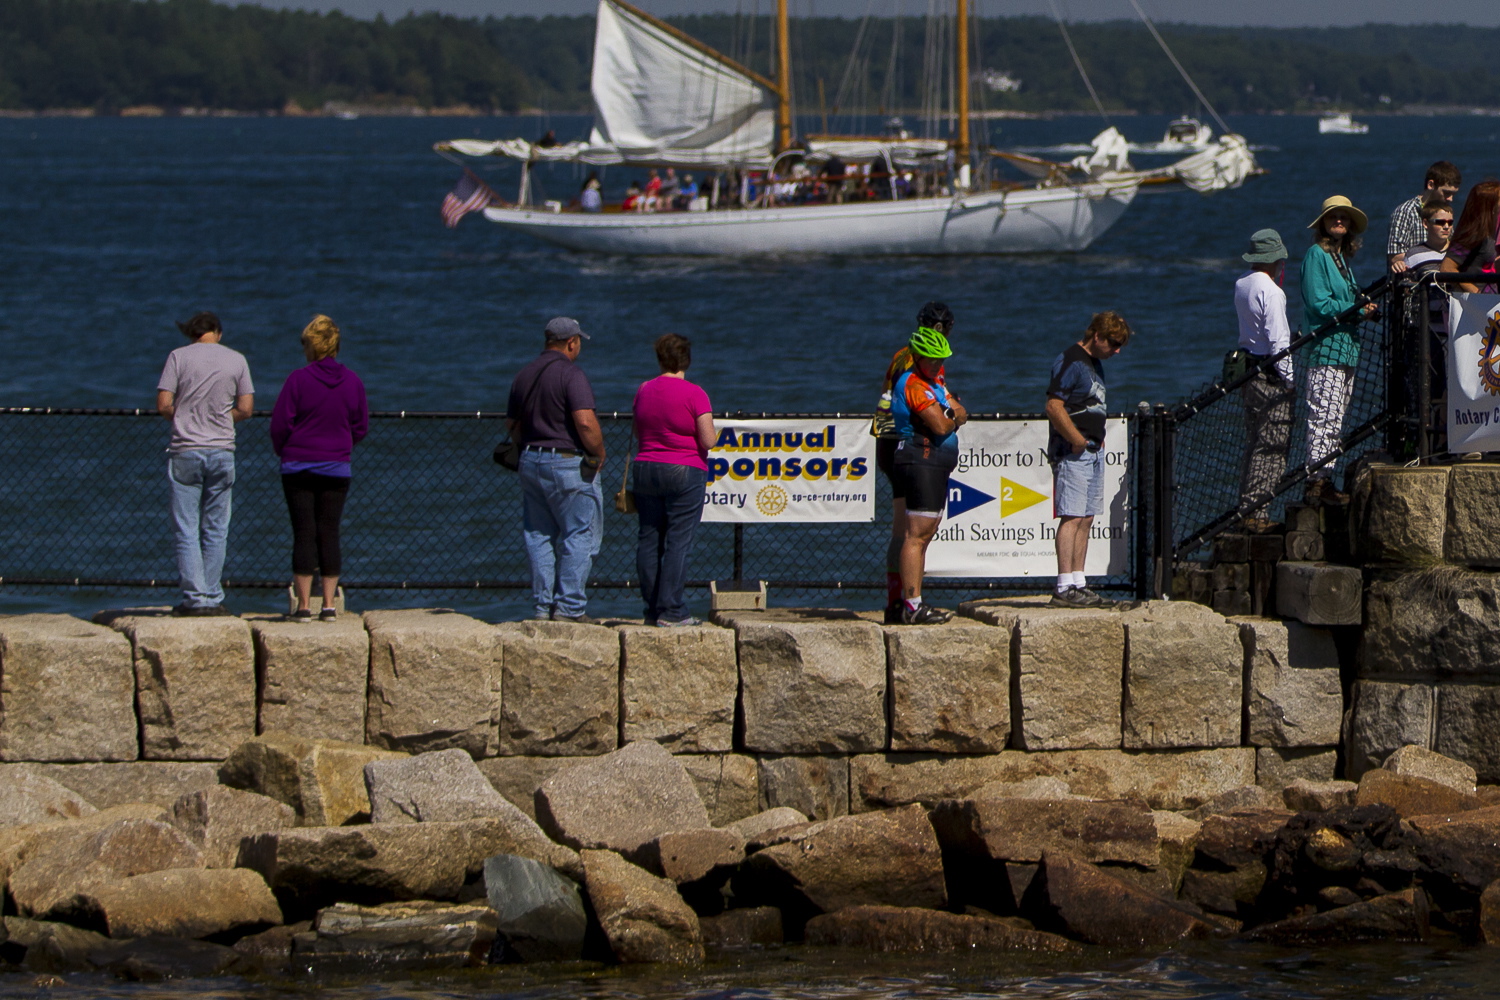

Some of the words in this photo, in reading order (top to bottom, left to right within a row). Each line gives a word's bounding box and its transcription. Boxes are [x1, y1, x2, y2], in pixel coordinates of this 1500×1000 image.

[1455, 409, 1490, 426] Rotary
[711, 425, 836, 452] Annual
[705, 456, 868, 486] ponsors
[958, 447, 1012, 473] ghbor
[1016, 450, 1033, 467] to
[703, 491, 747, 508] otary
[792, 492, 867, 502] sp-ce-rotary.org
[1003, 486, 1013, 501] 2
[970, 523, 1035, 545] Savings
[1039, 521, 1122, 540] Intion
